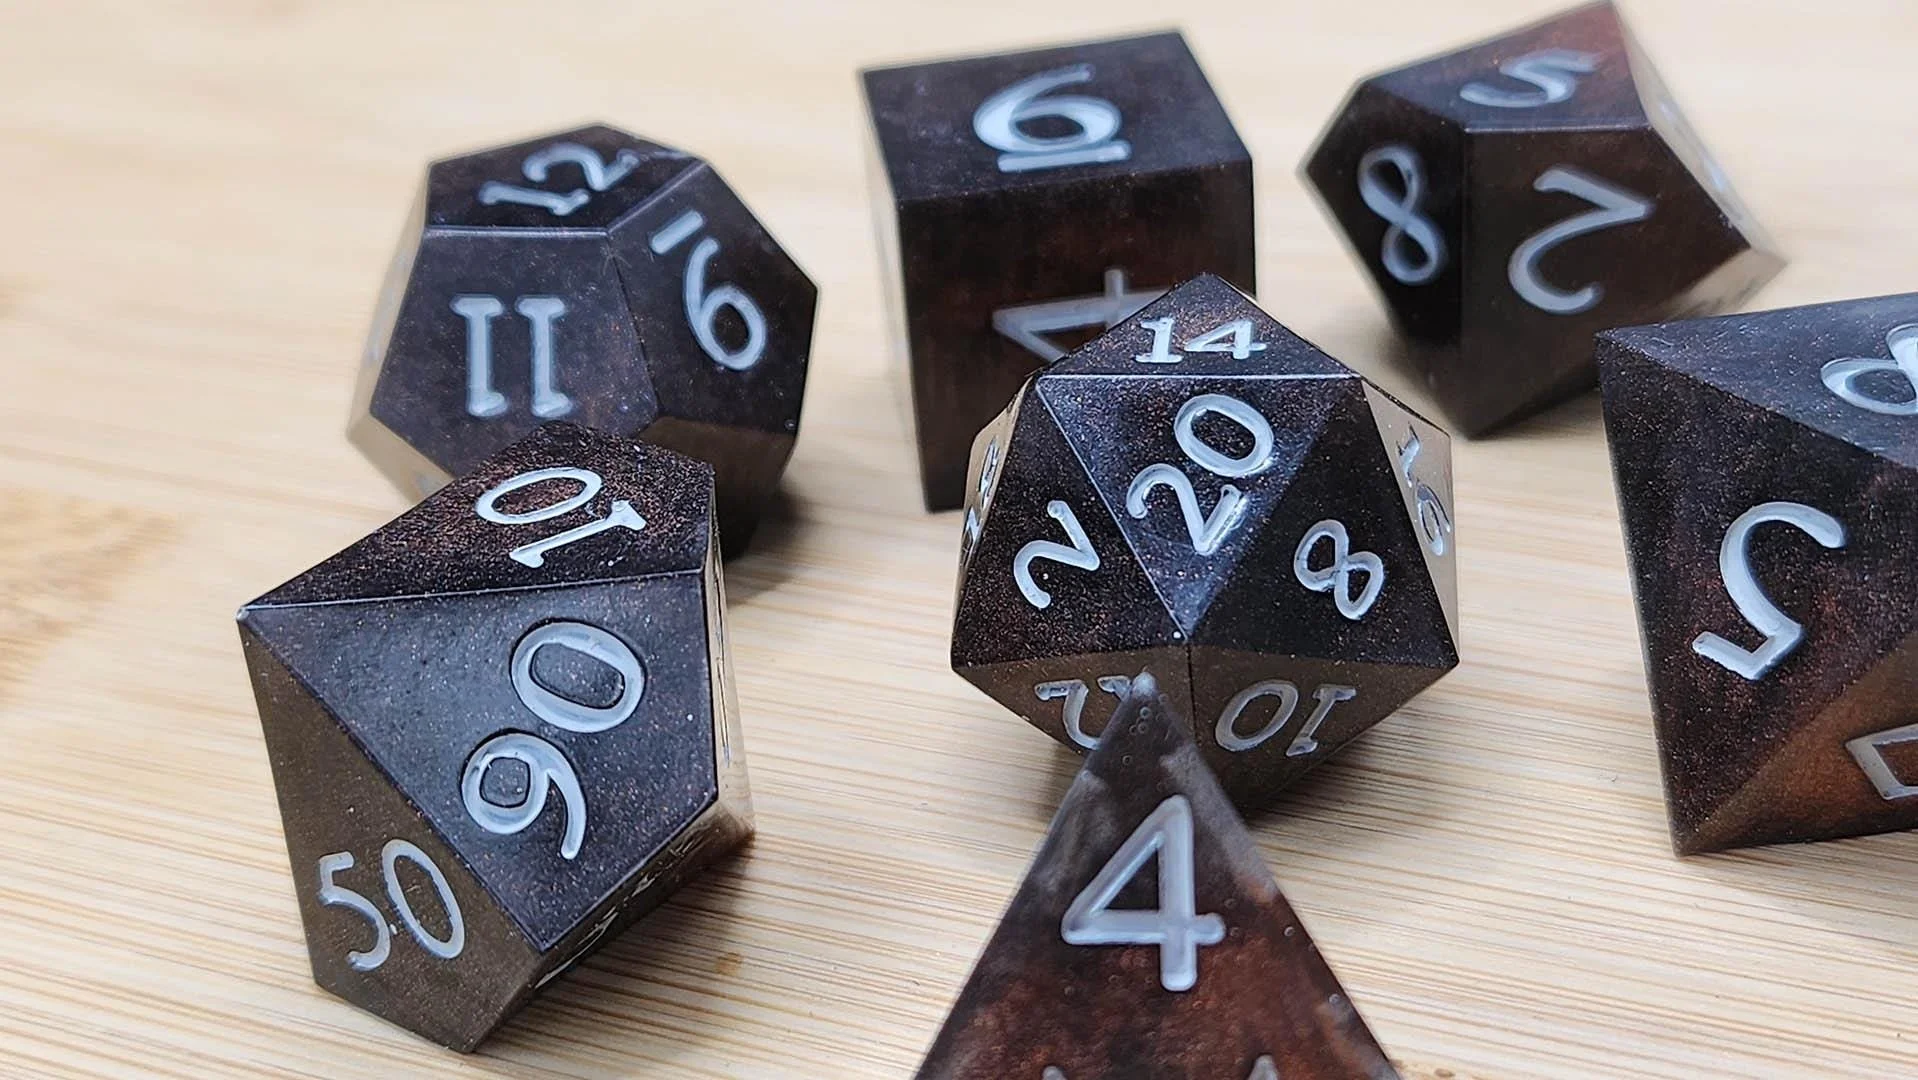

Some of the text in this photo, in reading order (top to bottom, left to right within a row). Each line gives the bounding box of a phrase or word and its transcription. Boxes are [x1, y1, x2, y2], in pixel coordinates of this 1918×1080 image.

[973, 56, 1132, 173] 6
[478, 142, 641, 217] 12
[1357, 145, 1445, 285] 8
[1508, 164, 1652, 315] 2
[449, 296, 573, 417] 11
[1135, 315, 1268, 363] 14
[475, 466, 648, 569] 10
[1126, 393, 1276, 556] 20
[1013, 499, 1101, 610] 2
[1293, 518, 1385, 621] 8
[1692, 501, 1848, 681] 5
[460, 618, 647, 862] 90
[1214, 678, 1357, 758] 10
[318, 838, 467, 973] 50
[1061, 795, 1228, 993] 4
